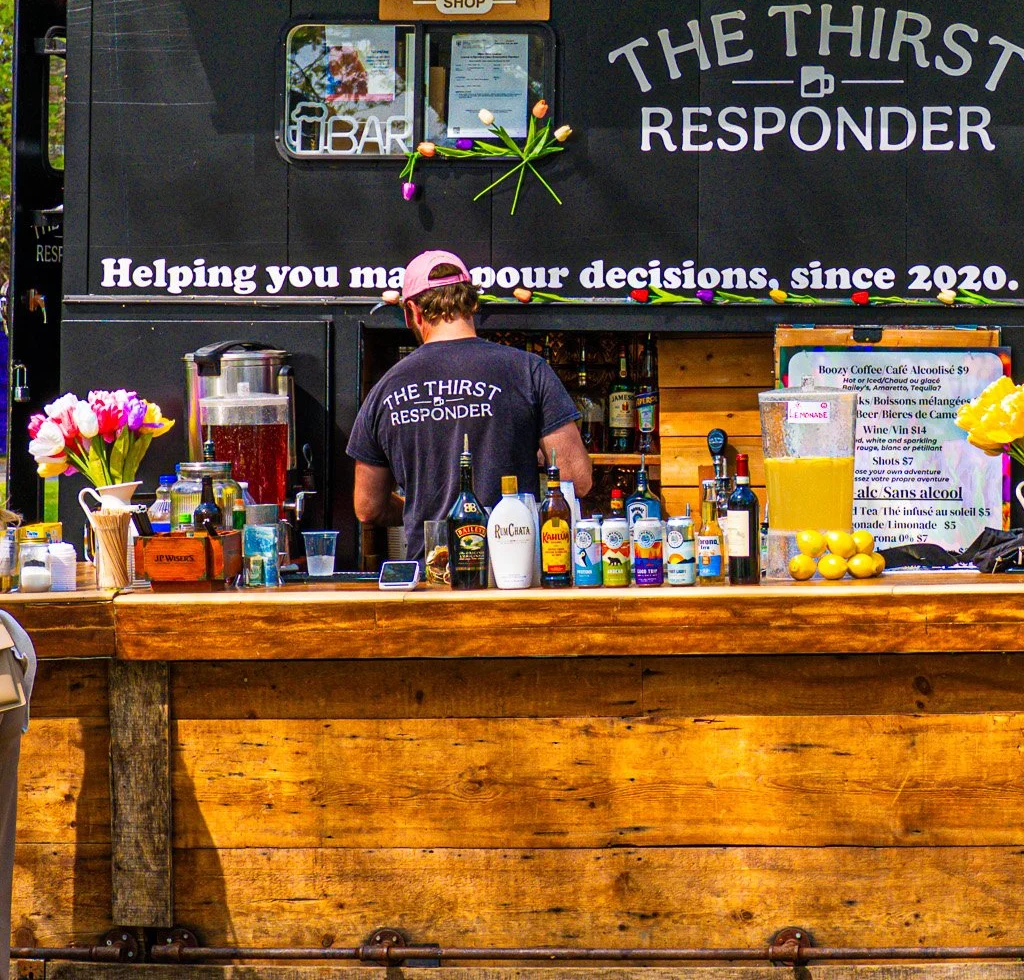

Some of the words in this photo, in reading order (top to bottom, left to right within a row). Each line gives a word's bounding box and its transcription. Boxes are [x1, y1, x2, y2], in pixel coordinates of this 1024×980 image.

[608, 10, 753, 93] THE
[328, 116, 413, 154] BAR
[640, 106, 996, 152] RESPONDER
[101, 258, 256, 293] Helping
[266, 265, 339, 293] you
[350, 265, 404, 288] ma
[470, 265, 569, 292] pour
[579, 260, 779, 291] decisions,
[791, 261, 895, 290] since
[907, 265, 1019, 291] 2020.
[820, 366, 848, 376] Boozy
[958, 366, 969, 374] $9
[384, 384, 420, 410] THE
[424, 379, 502, 401] THIRST
[390, 404, 492, 426] RESPONDER
[790, 408, 828, 418] LEMONADE
[912, 426, 926, 434] $14
[873, 457, 899, 465] Shots
[903, 457, 913, 465] $7
[920, 487, 962, 498] alcool
[904, 507, 933, 516] infusé
[950, 507, 976, 516] soleil
[979, 507, 991, 517] $5
